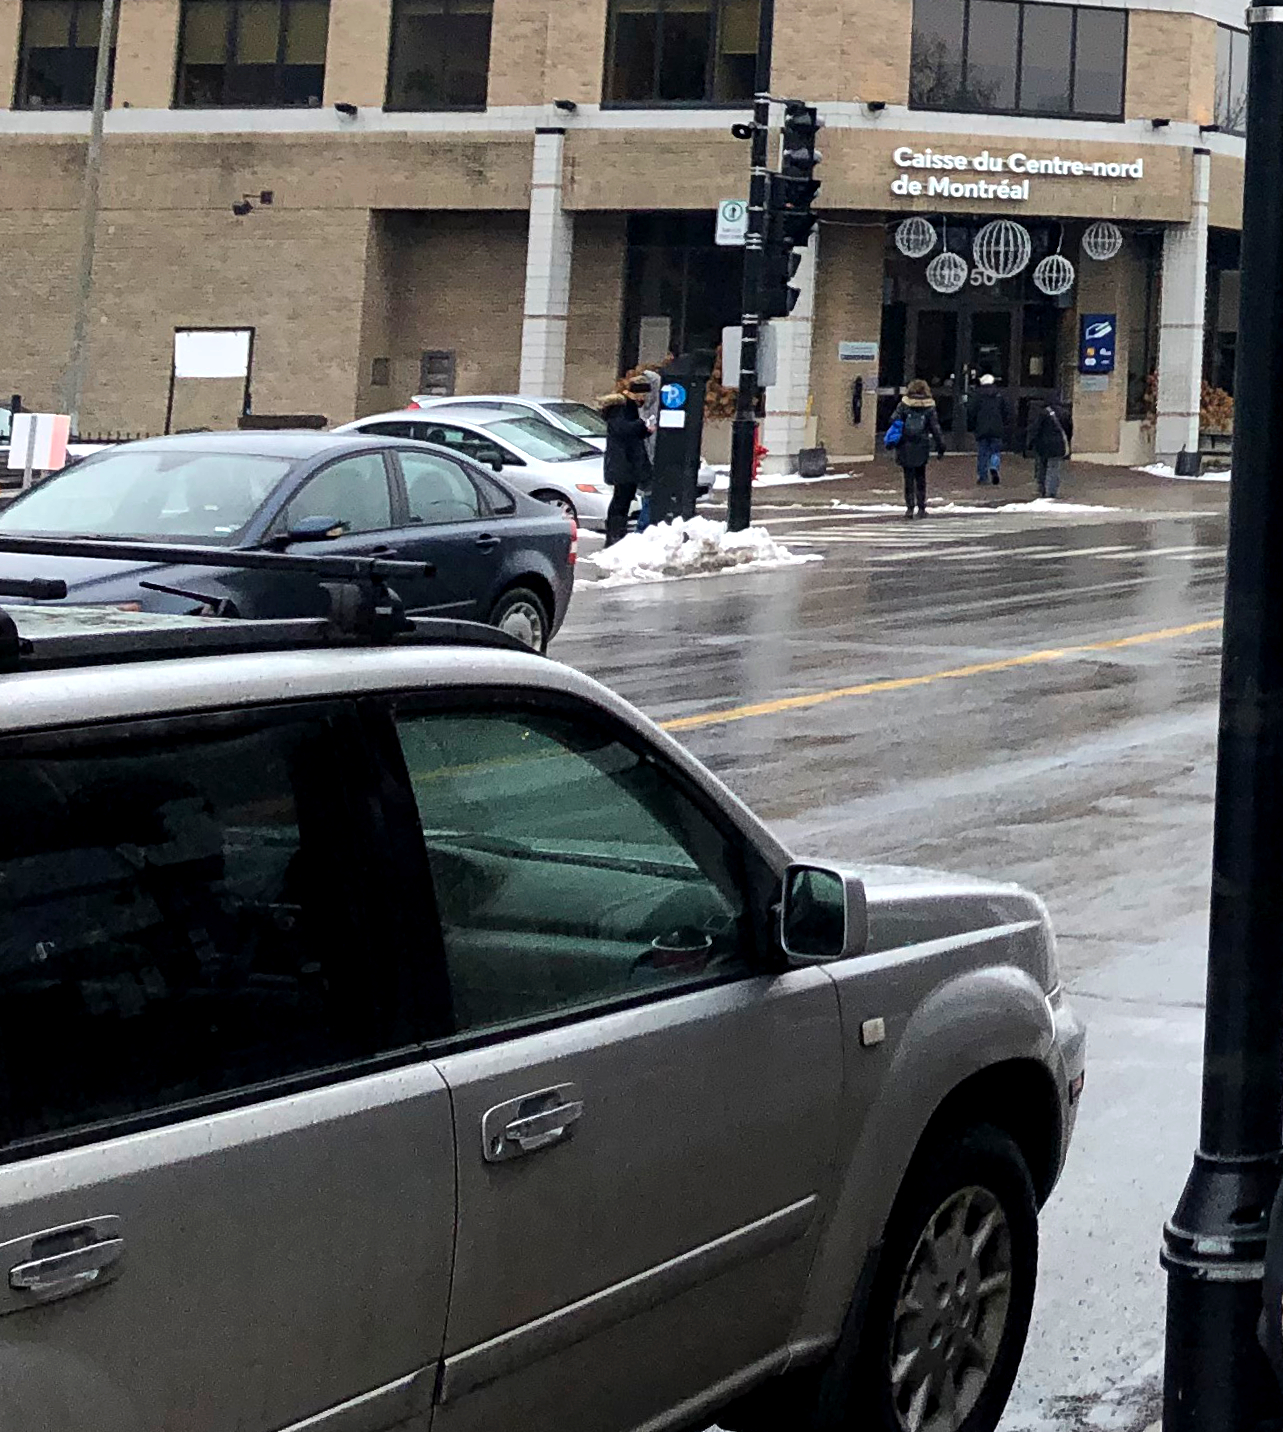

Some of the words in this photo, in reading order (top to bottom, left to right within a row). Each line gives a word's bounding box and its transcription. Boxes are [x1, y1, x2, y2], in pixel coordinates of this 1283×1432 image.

[893, 147, 968, 170] Caisse
[974, 150, 1004, 172] du
[1009, 153, 1143, 179] Centre-nord
[891, 174, 923, 195] de
[928, 176, 1030, 201] Montréal
